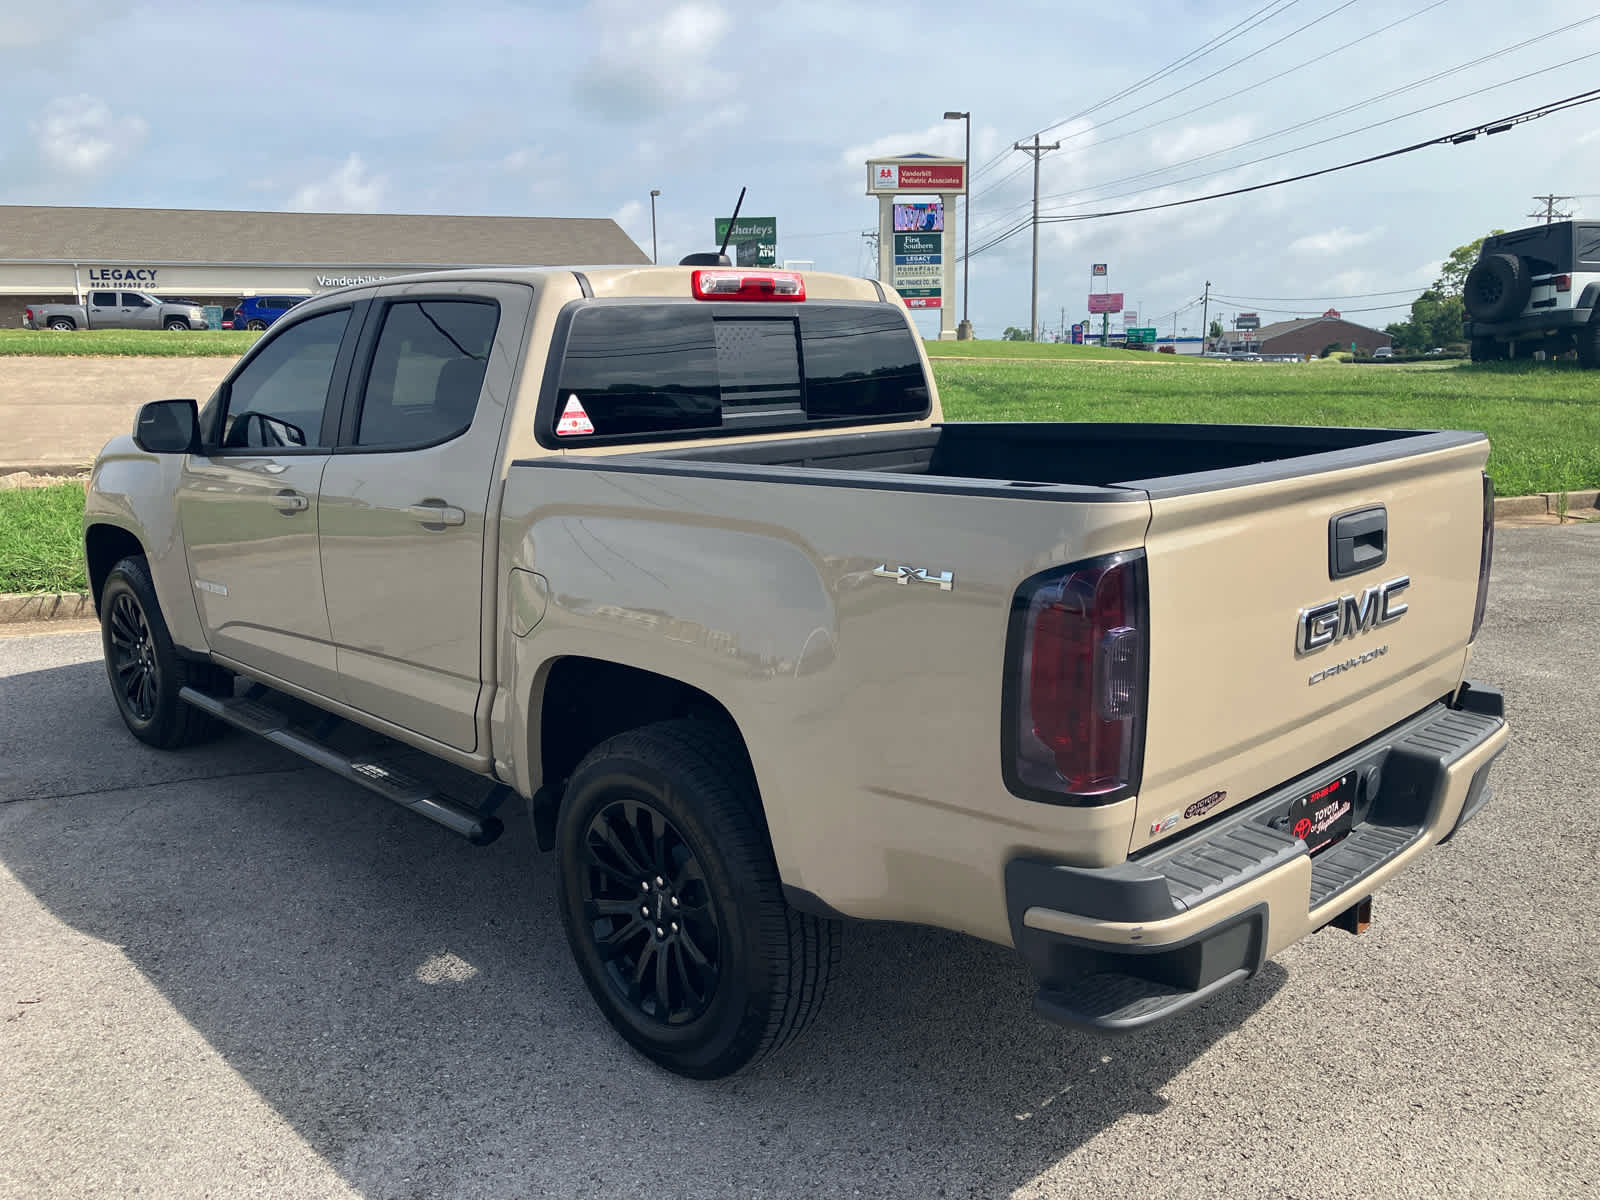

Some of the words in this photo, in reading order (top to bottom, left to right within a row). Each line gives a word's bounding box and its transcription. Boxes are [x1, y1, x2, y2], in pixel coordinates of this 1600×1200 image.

[759, 249, 775, 257] ATM
[89, 269, 157, 281] LEGACY
[316, 275, 379, 286] Vanderbilt
[1295, 575, 1410, 657] GMC
[1308, 645, 1388, 687] CANYON
[1315, 800, 1338, 823] TOYOTA
